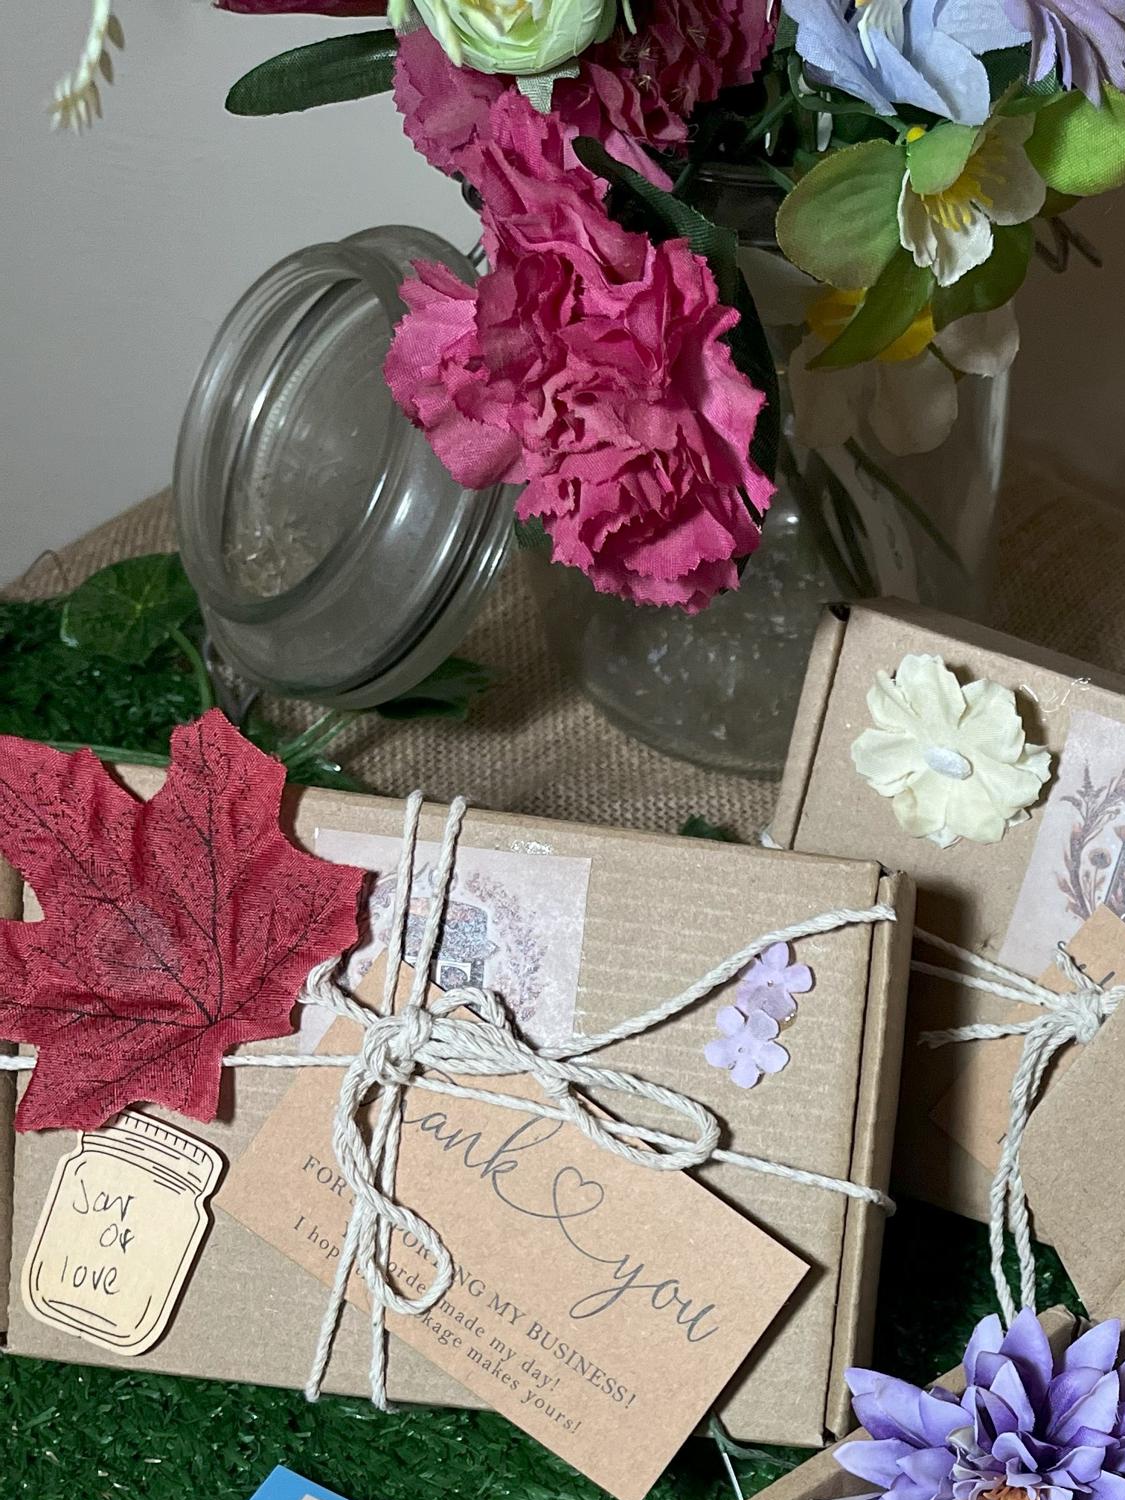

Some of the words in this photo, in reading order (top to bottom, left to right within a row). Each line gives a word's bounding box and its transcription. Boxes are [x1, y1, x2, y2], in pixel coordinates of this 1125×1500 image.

[61, 1255, 120, 1295] love
[294, 1216, 305, 1230] I
[307, 1226, 339, 1259] hop
[467, 1348, 519, 1389] makes
[520, 1390, 581, 1433] yours!
[302, 1155, 346, 1196] FOR
[487, 1293, 525, 1324] MY
[527, 1322, 635, 1408] BUSINESS!
[385, 1262, 425, 1292] orde
[439, 1300, 484, 1337] made
[489, 1337, 516, 1362] my
[521, 1359, 560, 1391] day!
[570, 1255, 716, 1341] you
